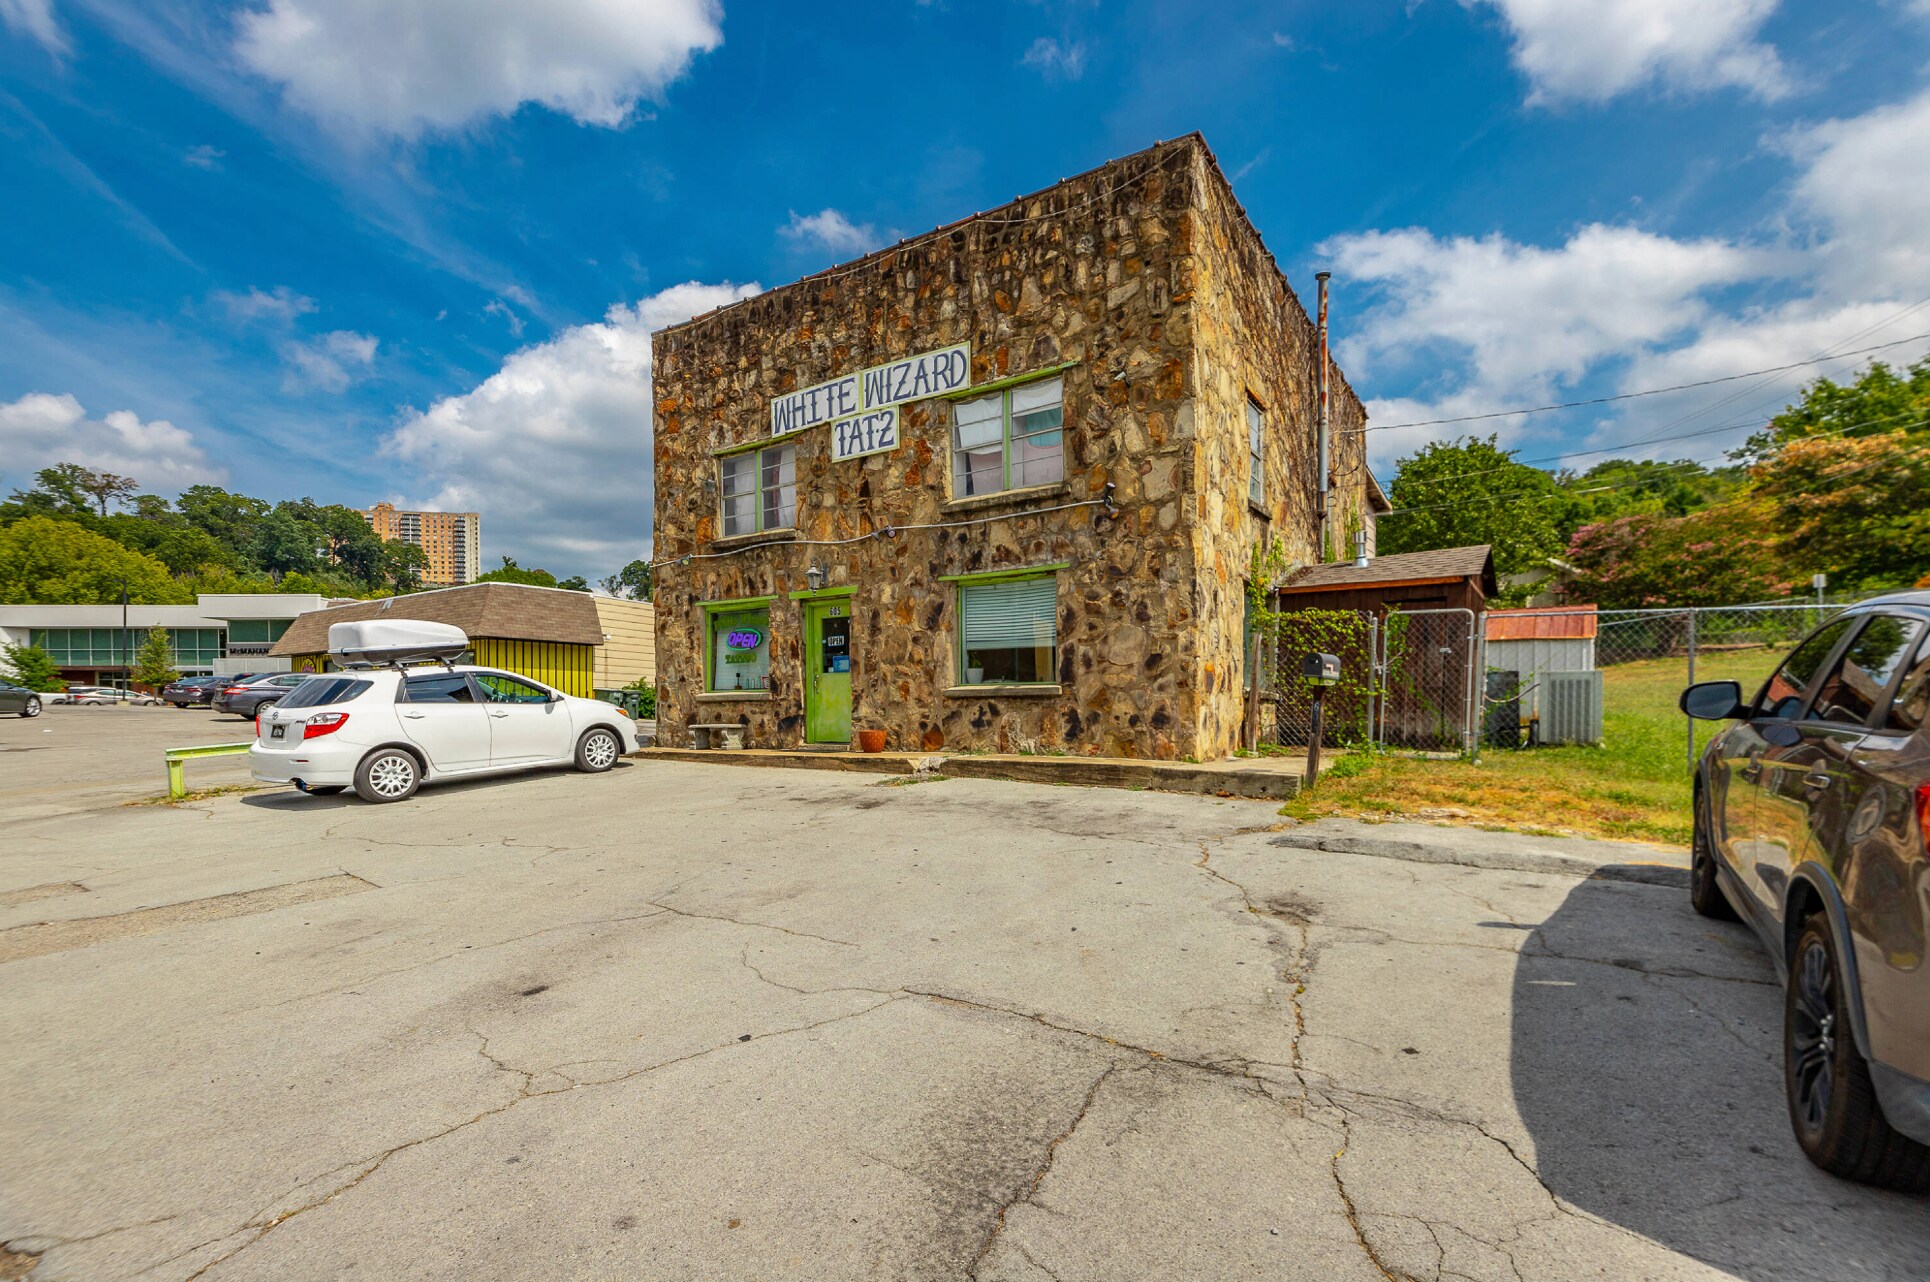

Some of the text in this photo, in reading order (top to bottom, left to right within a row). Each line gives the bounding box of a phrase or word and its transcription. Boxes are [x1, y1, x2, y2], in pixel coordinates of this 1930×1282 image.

[774, 349, 967, 434] WHITE WIZARD
[728, 632, 757, 648] OPEN
[828, 636, 844, 646] OPEN
